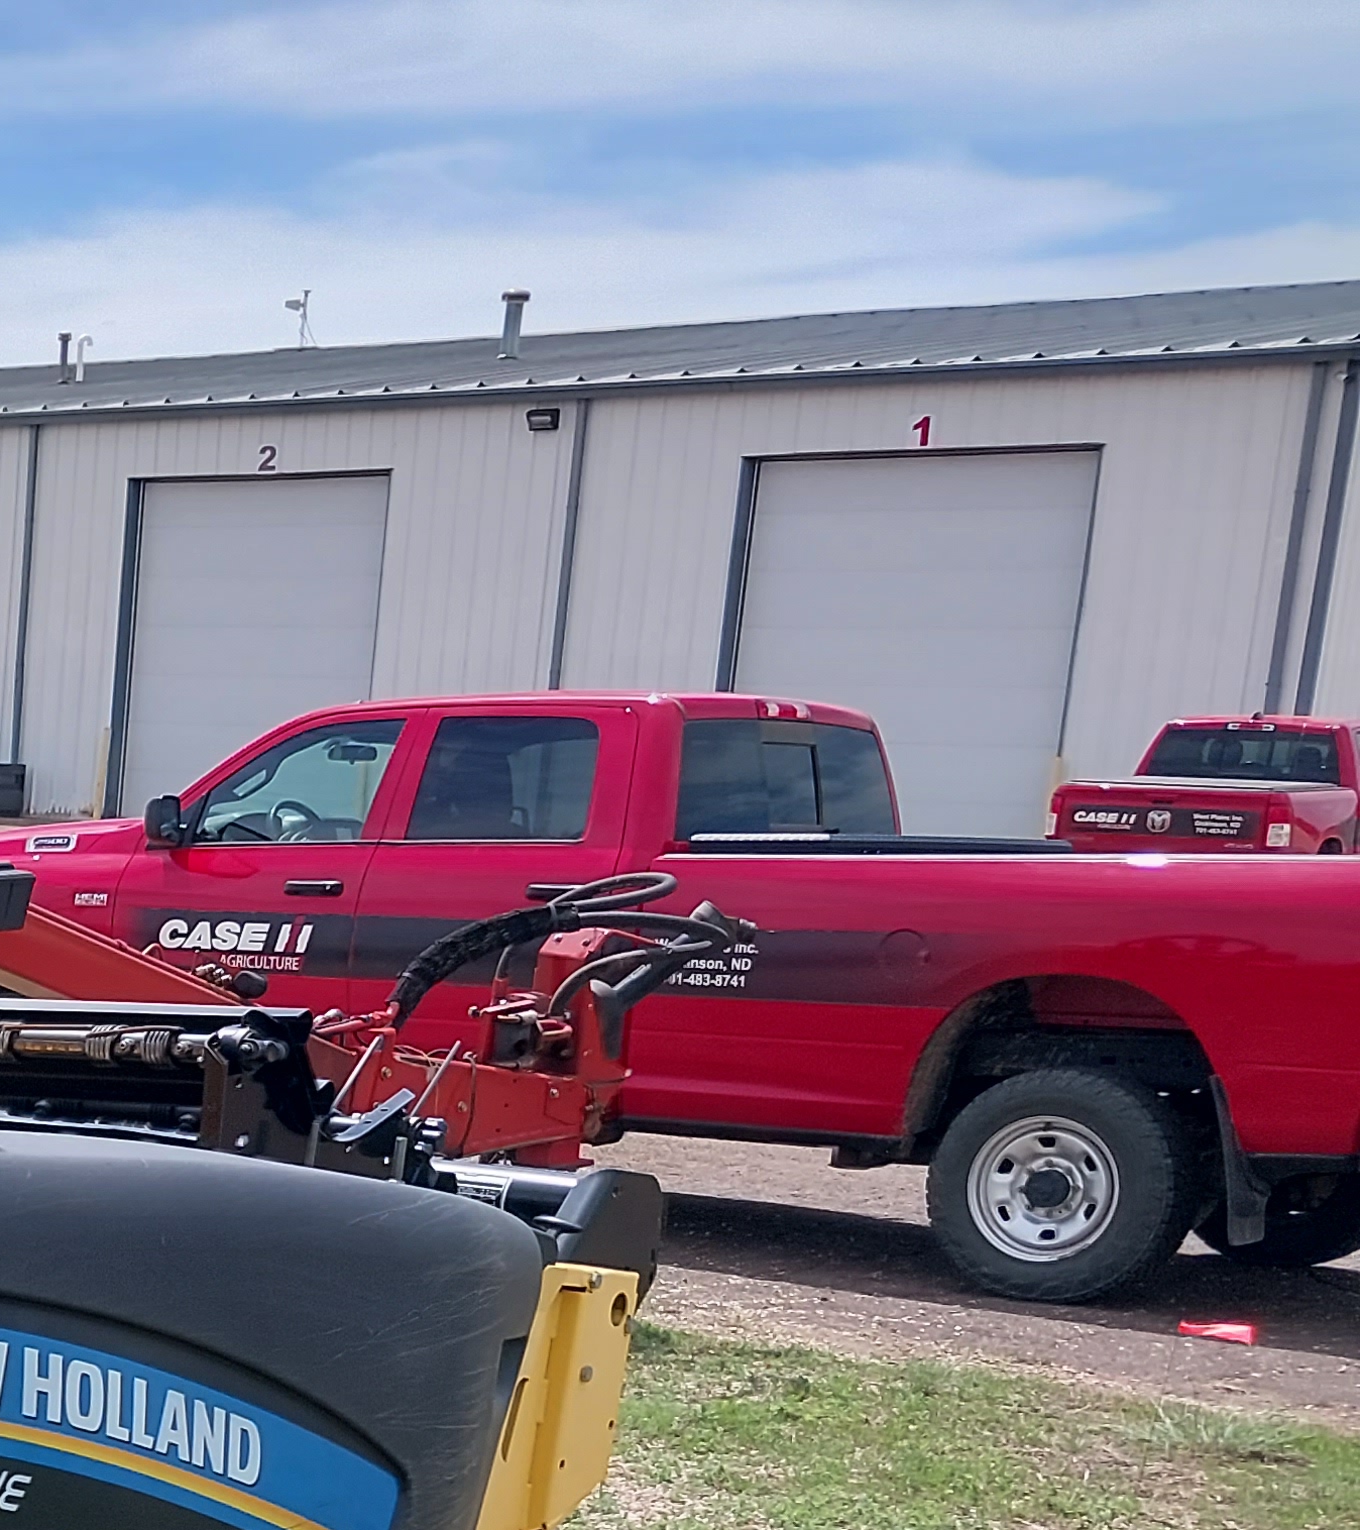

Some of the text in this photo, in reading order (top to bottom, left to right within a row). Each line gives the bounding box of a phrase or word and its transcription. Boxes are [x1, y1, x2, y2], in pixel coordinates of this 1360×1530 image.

[912, 415, 931, 446] 1
[257, 445, 277, 472] 2
[1073, 811, 1119, 823] CASE
[159, 919, 270, 951] CASE
[220, 954, 300, 971] AGRICULTURE
[730, 957, 752, 971] ND
[21, 1346, 261, 1486] HOLLAND
